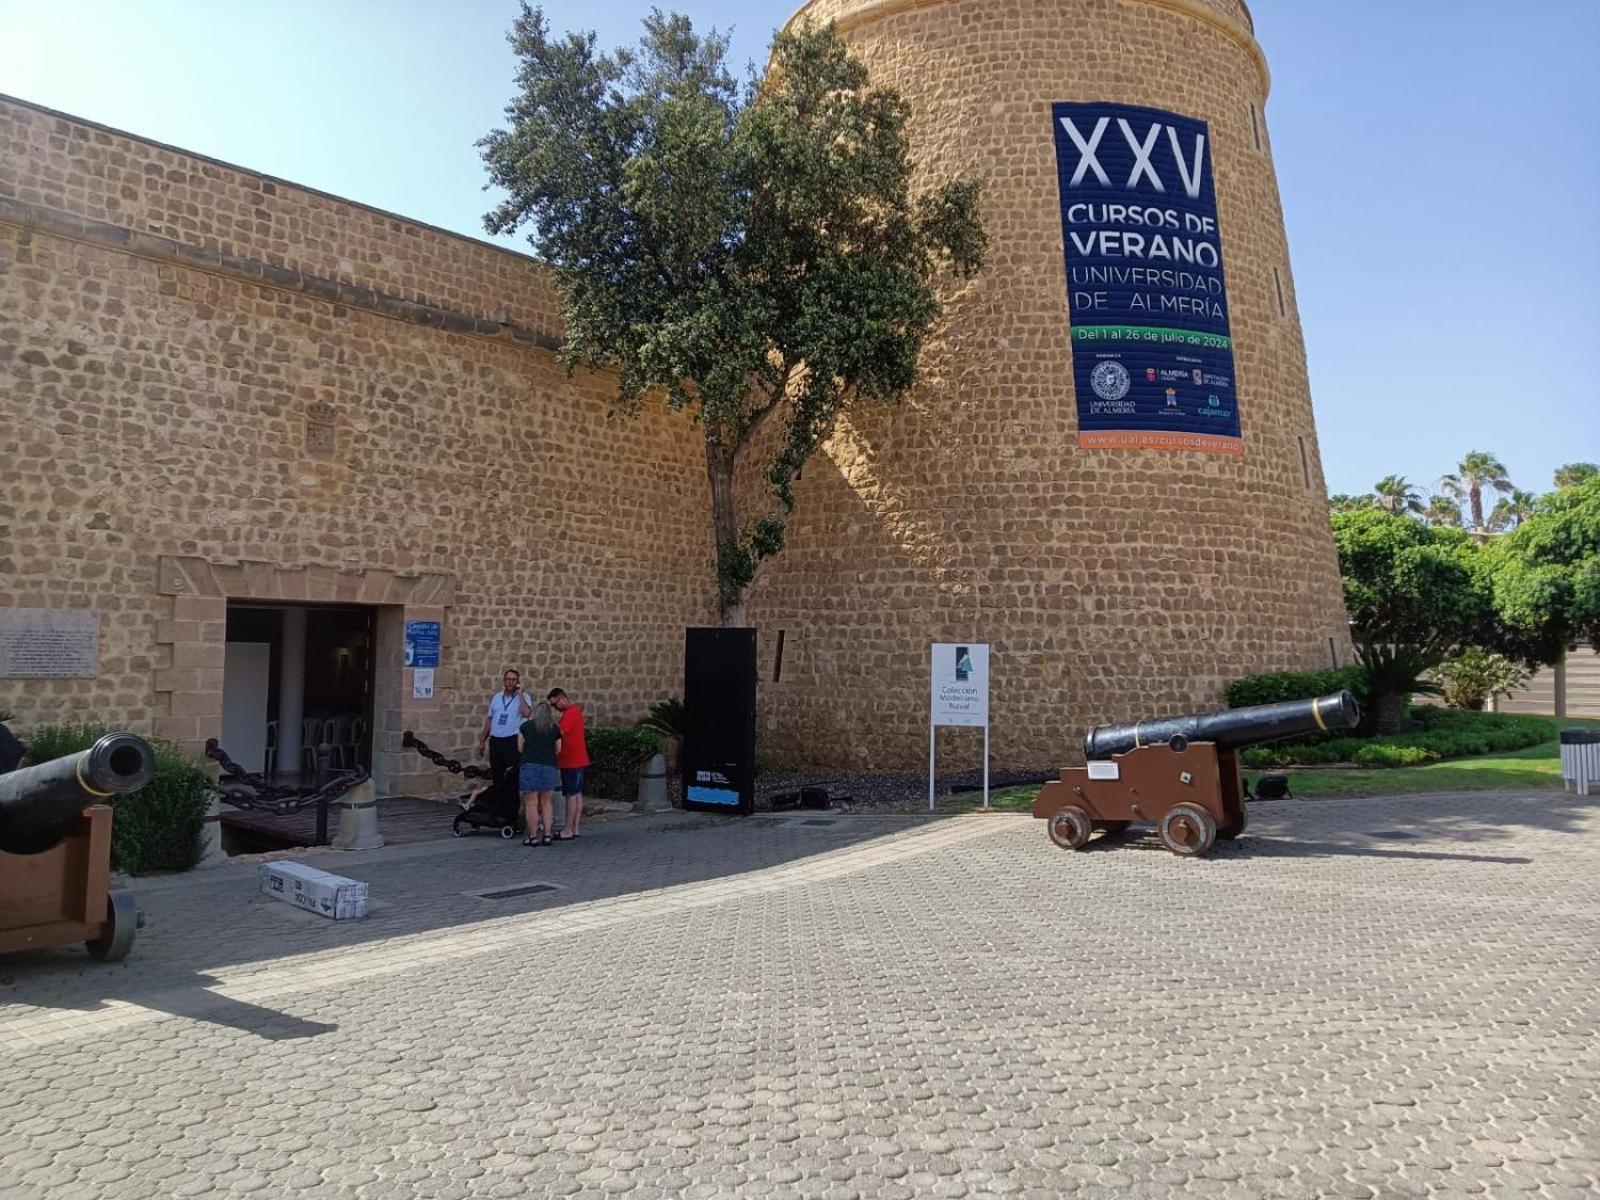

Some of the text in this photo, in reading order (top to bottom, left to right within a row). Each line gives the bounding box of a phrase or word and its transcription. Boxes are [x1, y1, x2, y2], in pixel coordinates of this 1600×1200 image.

[1059, 116, 1205, 199] XXV
[1067, 203, 1215, 235] CURSOS DE
[1069, 230, 1219, 269] VERANO
[1072, 266, 1222, 295] UNIVERSIDAD
[1074, 291, 1225, 321] DE ALMERÍA
[1078, 329, 1099, 340] Del
[1110, 329, 1121, 340] al
[1125, 330, 1140, 340] 26
[1143, 331, 1158, 341] de
[1161, 332, 1185, 343] julio
[1187, 334, 1201, 344] de
[1203, 336, 1228, 349] 2024
[1198, 406, 1231, 417] cajamar
